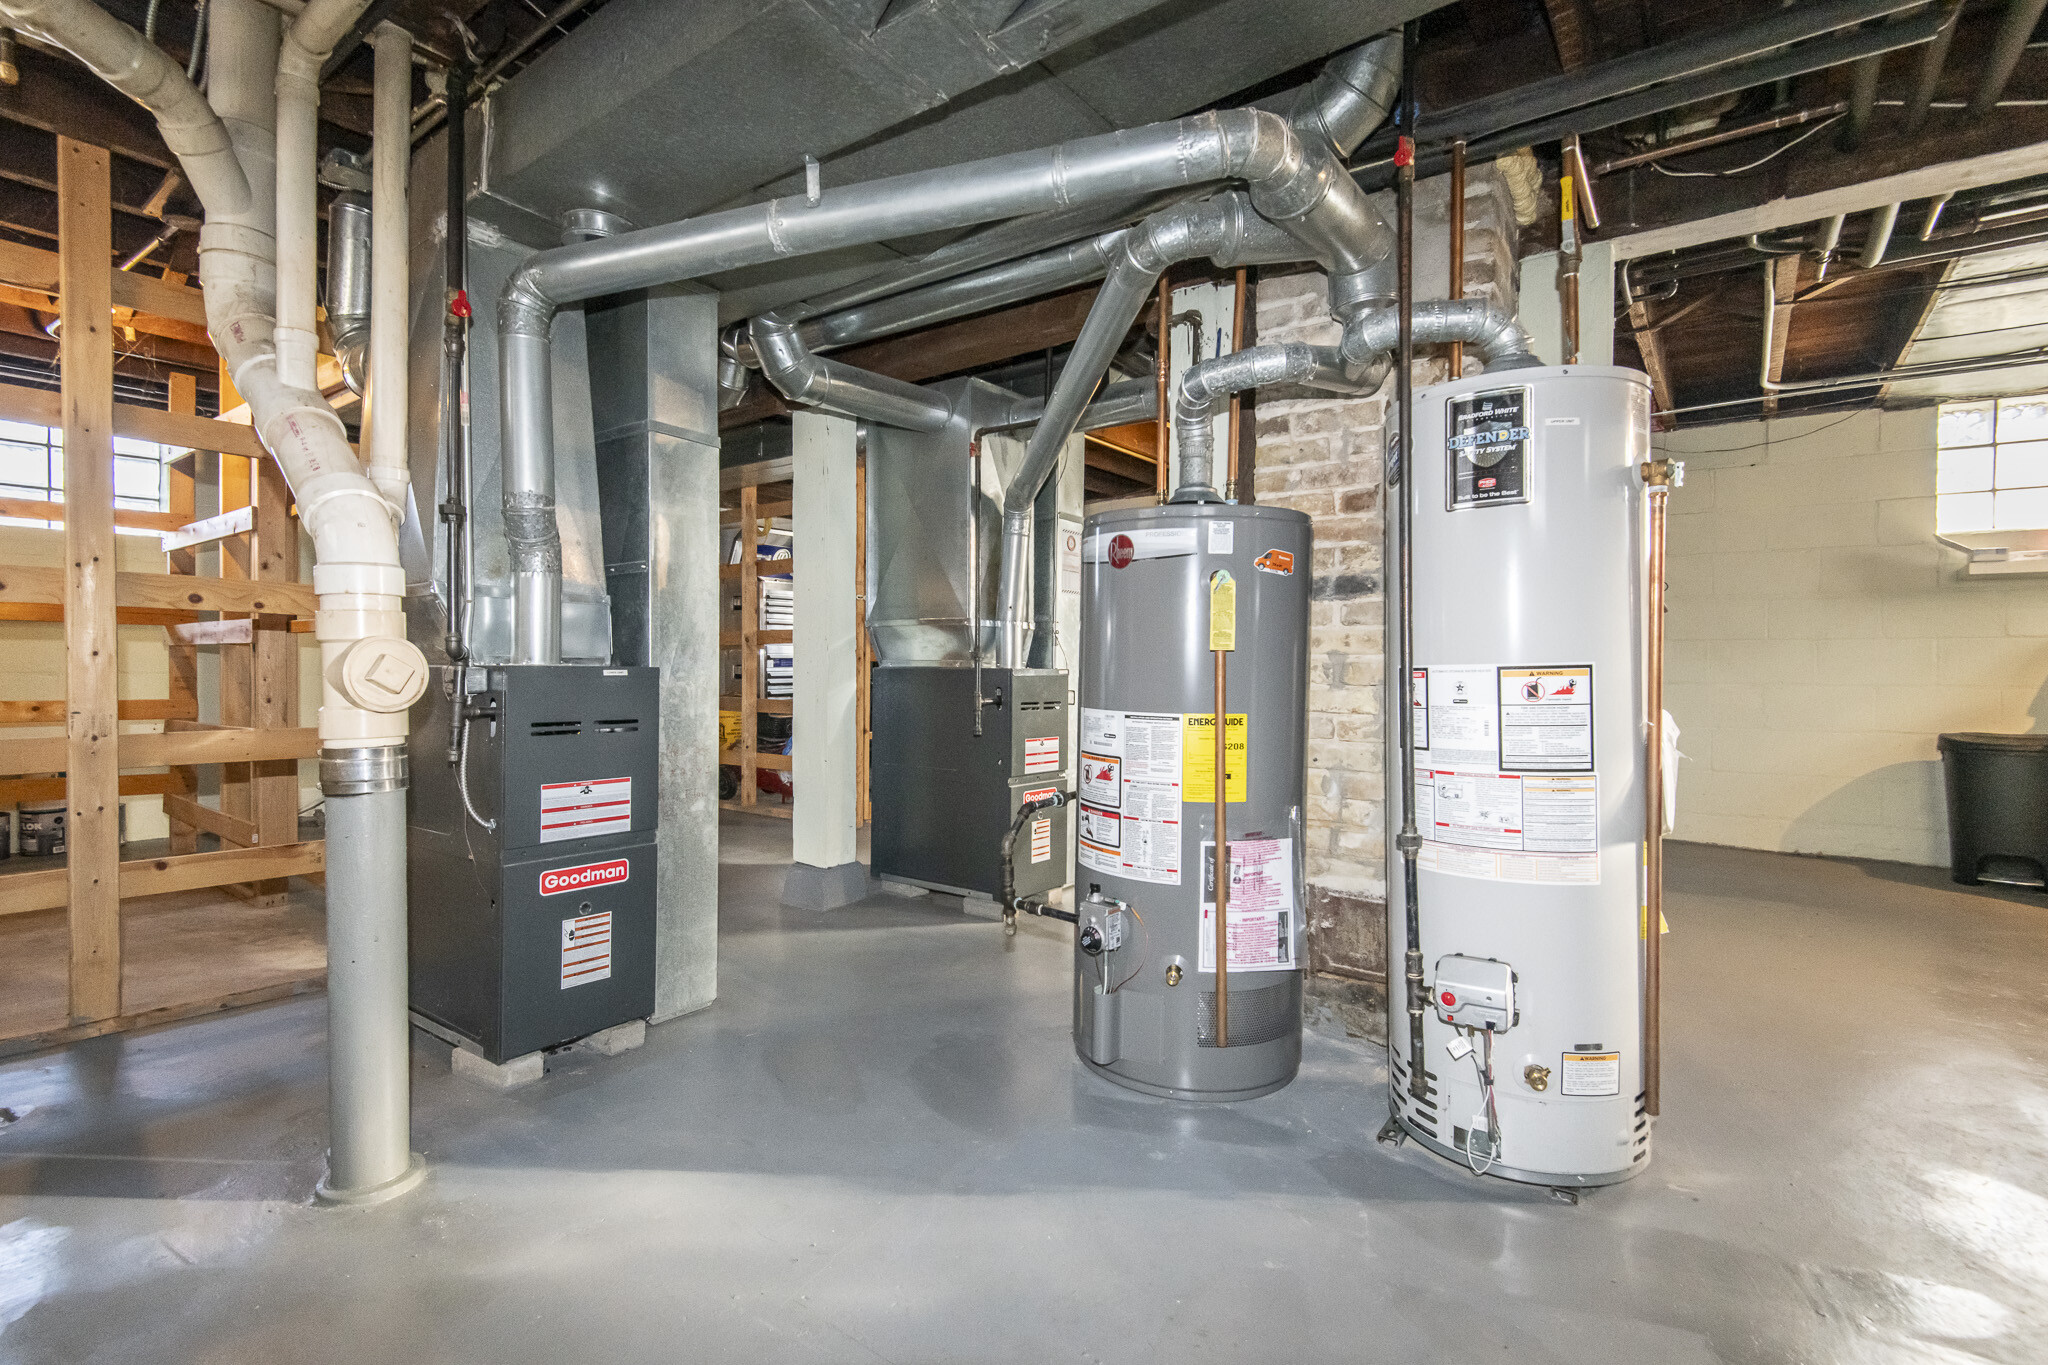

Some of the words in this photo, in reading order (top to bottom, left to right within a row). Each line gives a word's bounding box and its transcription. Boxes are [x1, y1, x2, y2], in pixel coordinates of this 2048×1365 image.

[1458, 410, 1494, 421] BRADFORD
[1494, 406, 1519, 415] WHITE
[1448, 427, 1531, 450] DEFENDER
[1486, 444, 1516, 454] SYSTEM
[1110, 536, 1133, 564] Rheem
[544, 865, 625, 889] Goodman
